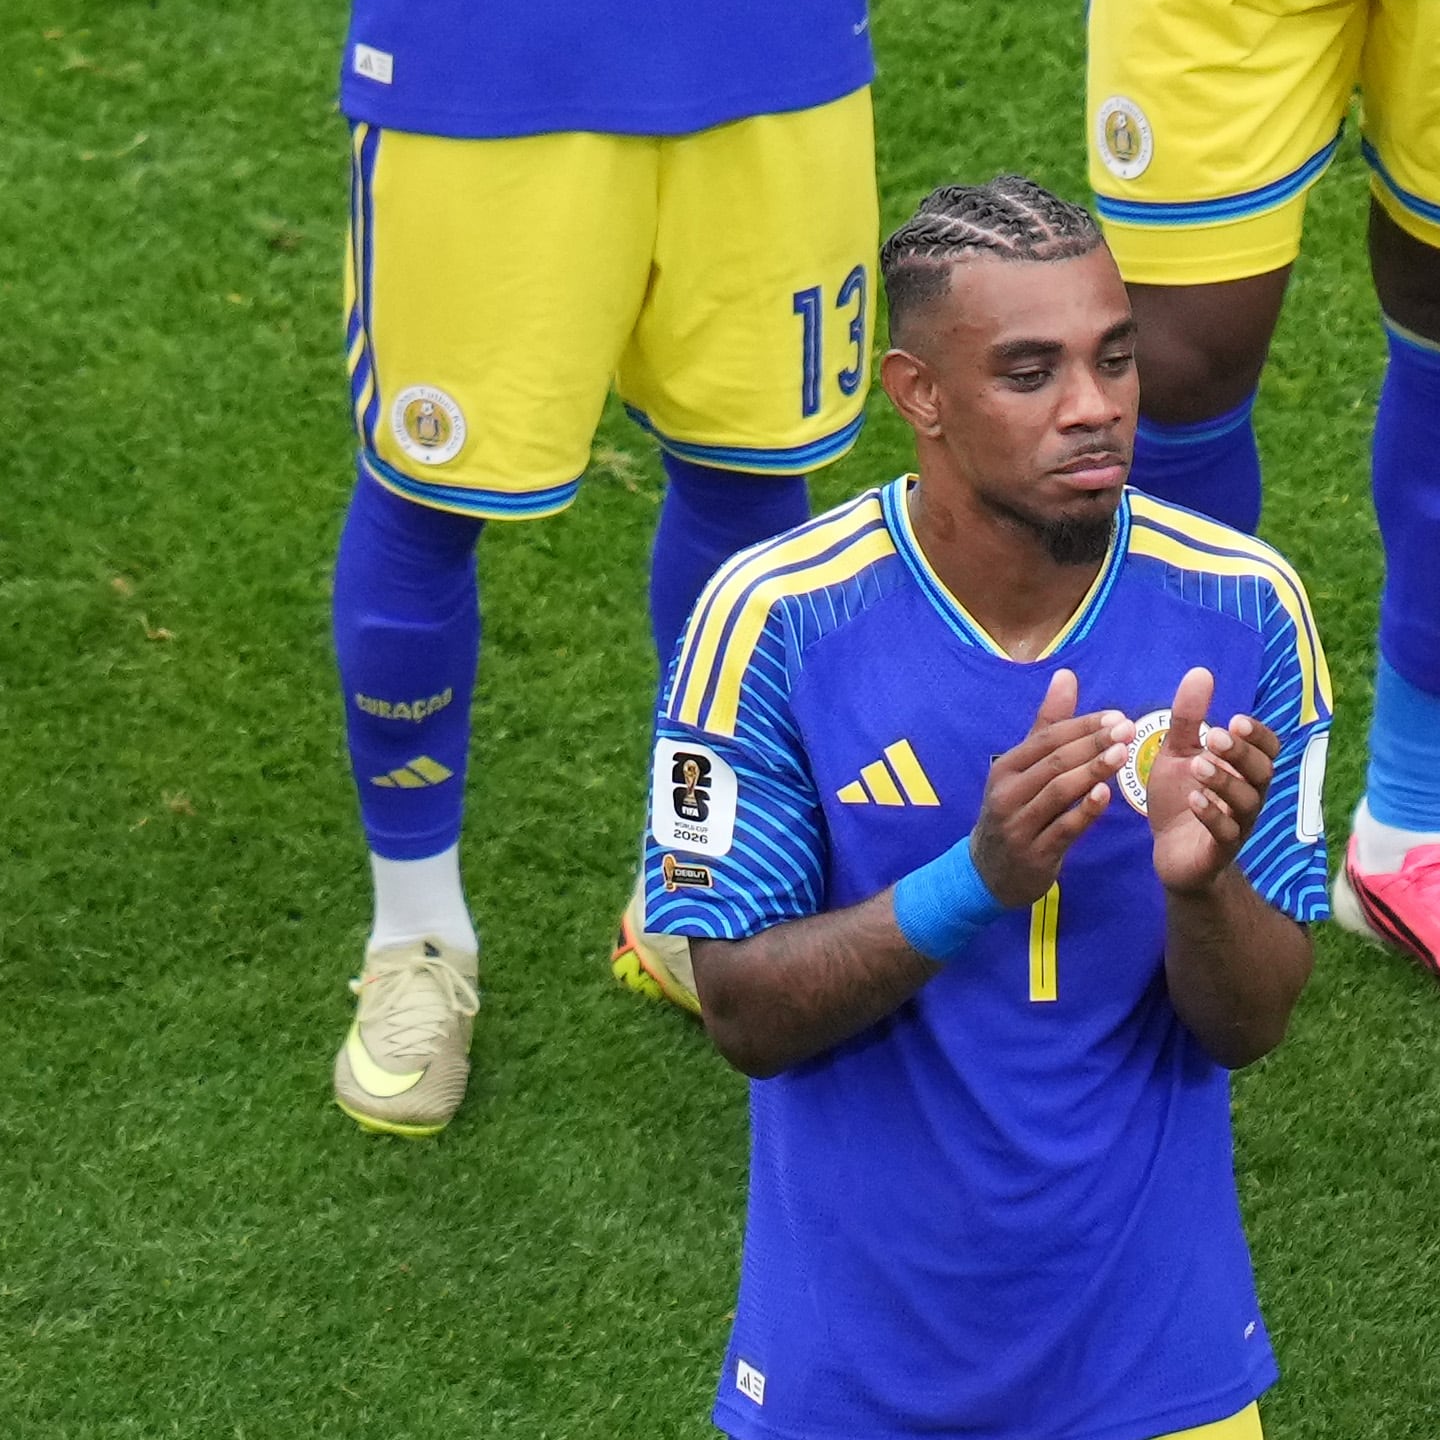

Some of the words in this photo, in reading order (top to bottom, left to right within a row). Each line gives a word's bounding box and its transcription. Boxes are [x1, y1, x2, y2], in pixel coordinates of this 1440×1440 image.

[793, 263, 866, 419] 13
[681, 805, 700, 818] FIFA
[674, 821, 695, 832] WORLD
[695, 825, 709, 833] CUP
[673, 828, 709, 845] 2026
[674, 868, 706, 880] DEBUT
